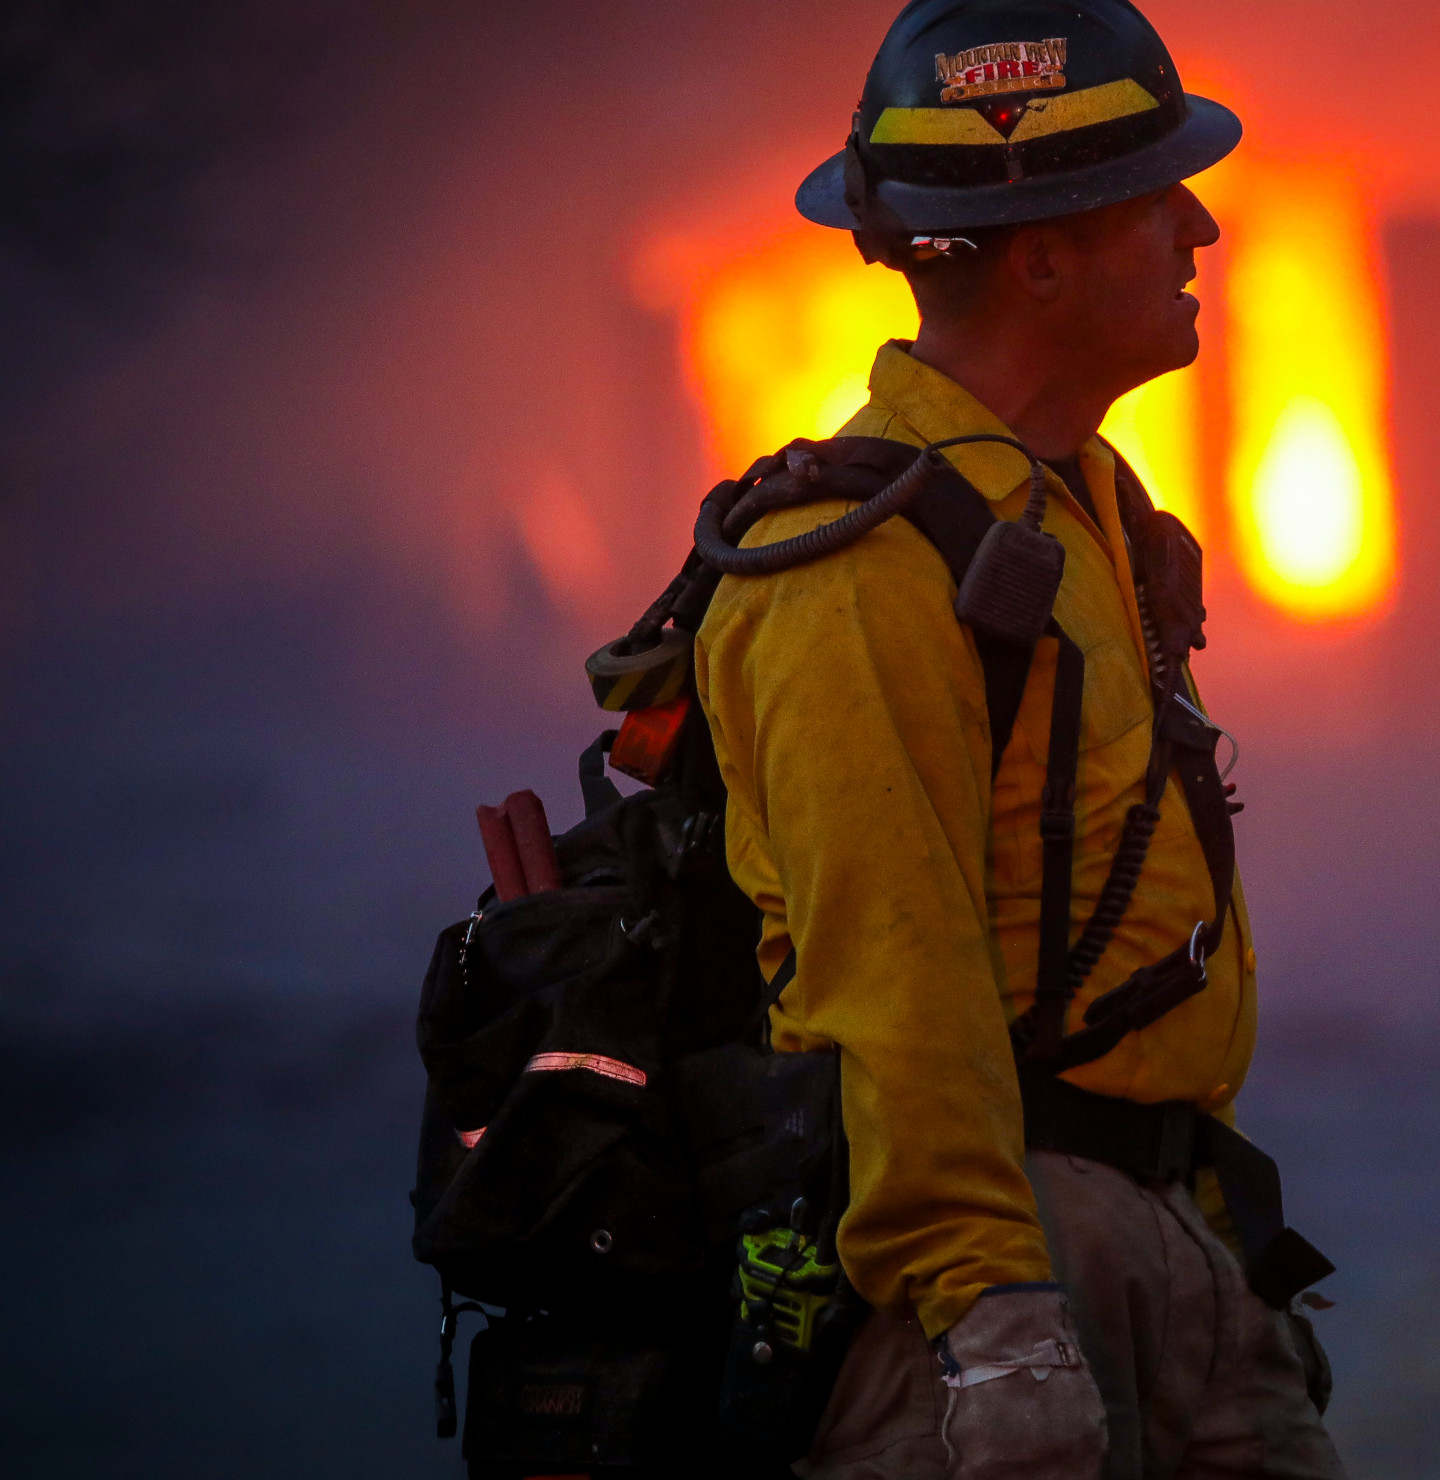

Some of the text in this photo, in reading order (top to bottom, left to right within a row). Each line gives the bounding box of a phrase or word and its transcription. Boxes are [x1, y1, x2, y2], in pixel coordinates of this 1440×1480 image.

[936, 38, 1066, 79] MOUNTAIN VIEW
[965, 60, 1043, 83] FIRE
